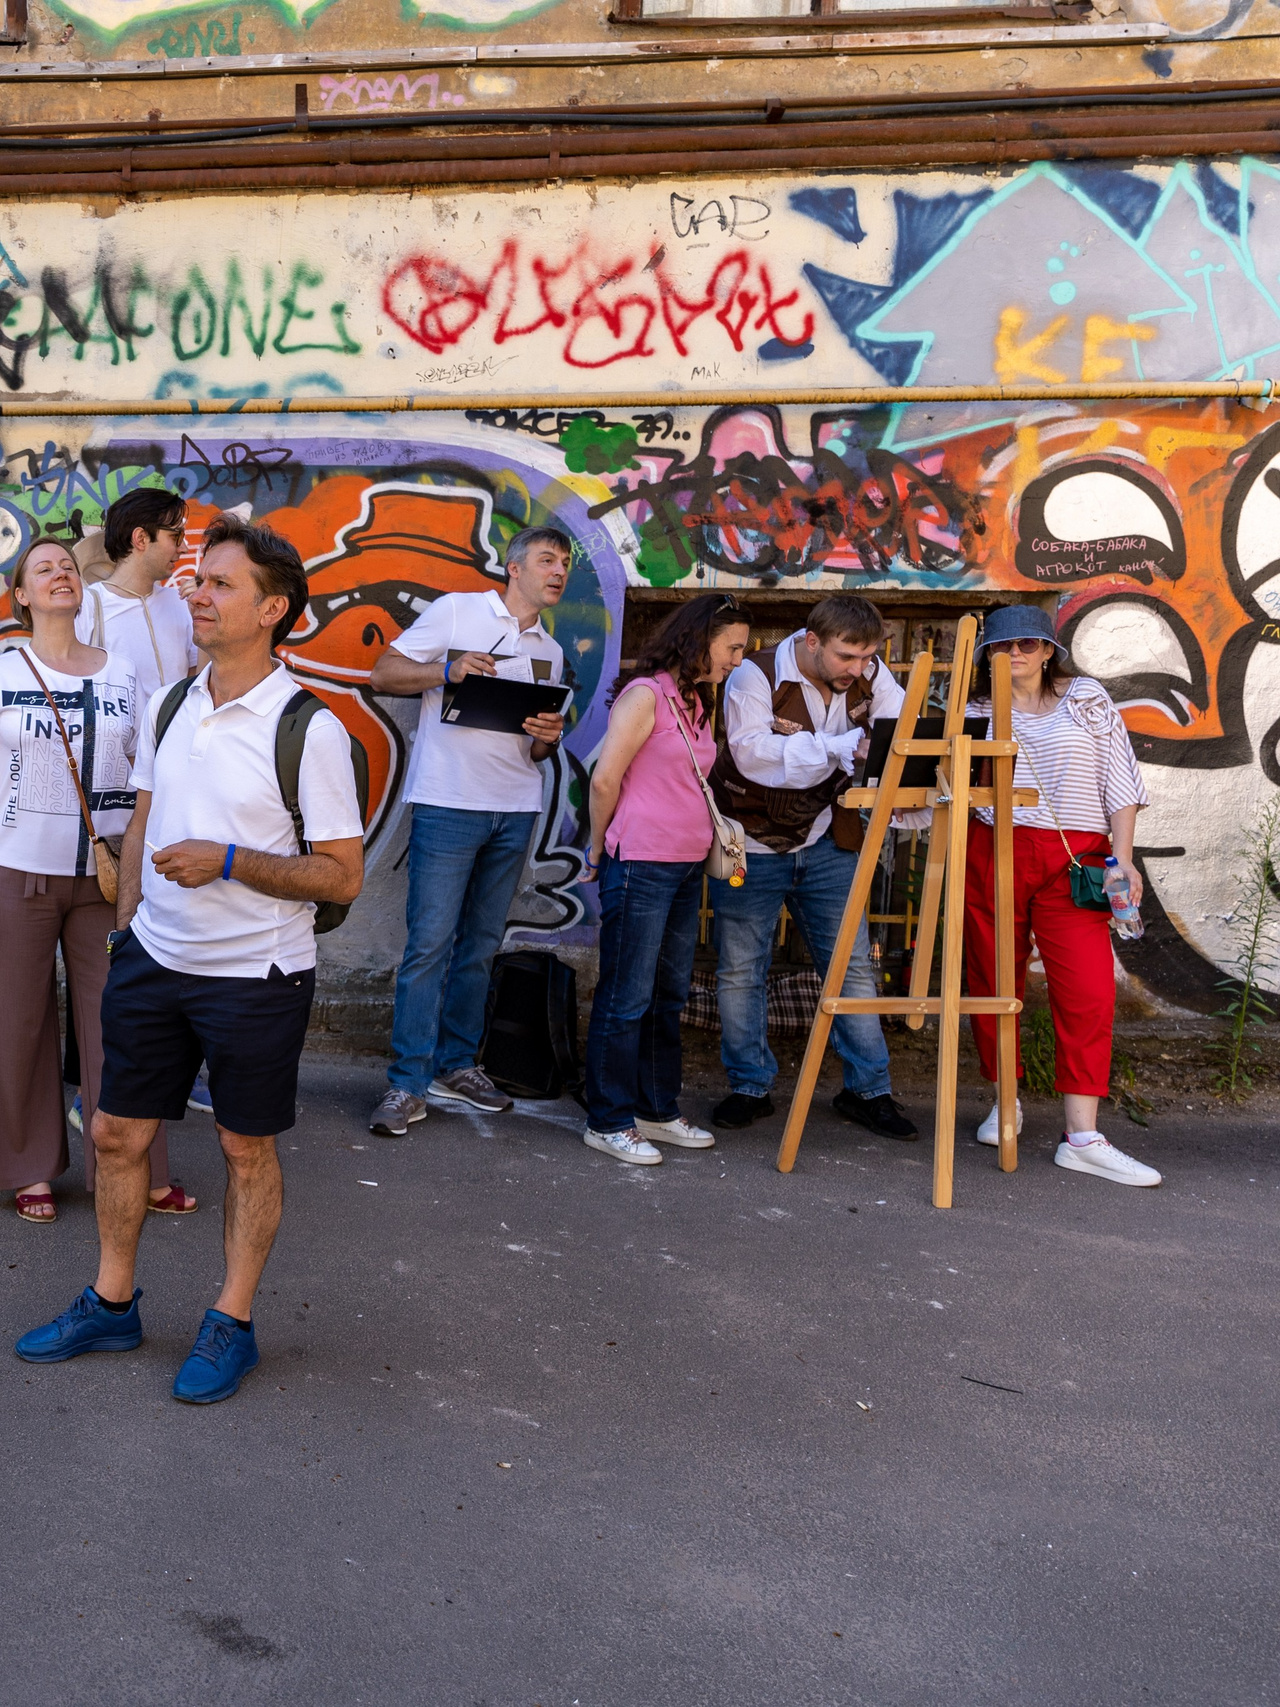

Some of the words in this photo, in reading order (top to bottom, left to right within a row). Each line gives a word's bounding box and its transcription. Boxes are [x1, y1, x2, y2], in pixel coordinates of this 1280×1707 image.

[1031, 537, 1147, 552] СОБАКА-БАБАКА
[1084, 553, 1094, 562] И
[1036, 560, 1107, 577] АГРОКОТ
